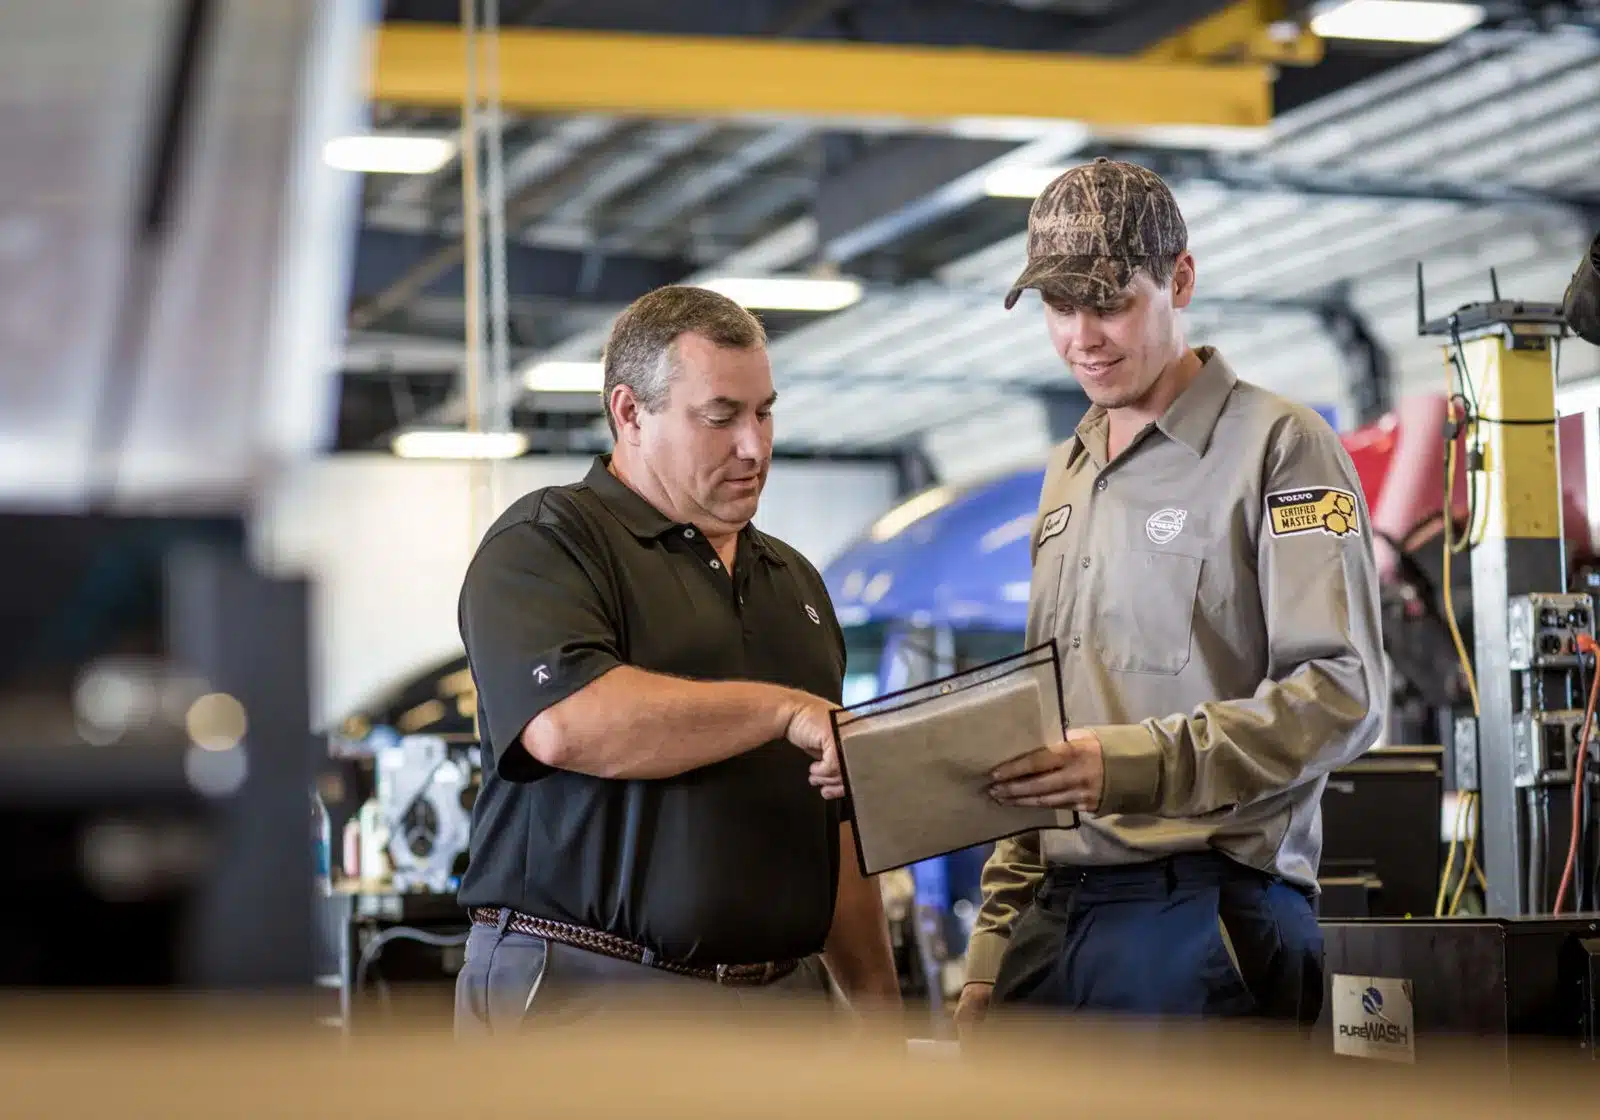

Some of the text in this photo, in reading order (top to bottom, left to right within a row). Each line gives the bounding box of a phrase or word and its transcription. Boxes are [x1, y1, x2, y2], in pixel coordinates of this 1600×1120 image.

[1278, 493, 1313, 503] VOLVO
[1280, 504, 1316, 518] CERTIFIED
[1150, 521, 1179, 531] VOLVO
[1281, 514, 1318, 529] MASTER
[1339, 1021, 1408, 1045] PUREWASH
